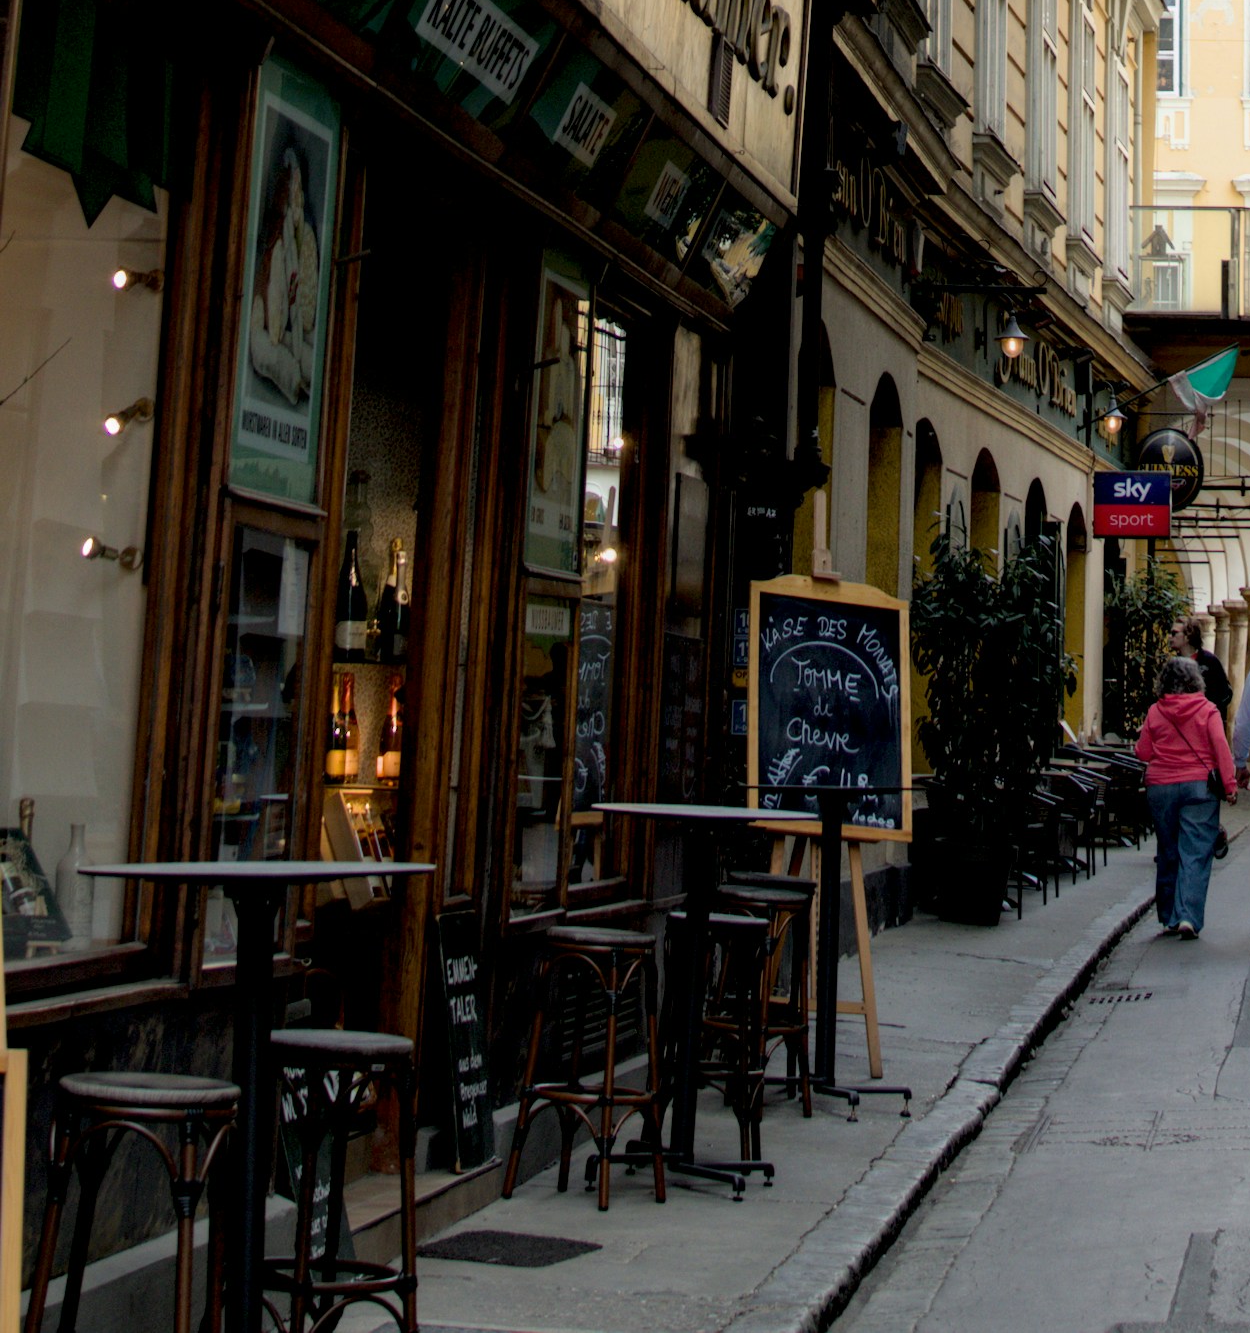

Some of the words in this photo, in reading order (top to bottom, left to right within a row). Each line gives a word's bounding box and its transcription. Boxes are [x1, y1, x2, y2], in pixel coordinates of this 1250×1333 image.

[562, 94, 610, 156] SALATE
[1113, 477, 1152, 503] sky
[1109, 513, 1154, 529] sport
[818, 616, 847, 640] DES
[856, 623, 899, 700] MONATS
[790, 656, 862, 696] TOMME
[449, 994, 478, 1025] TALER
